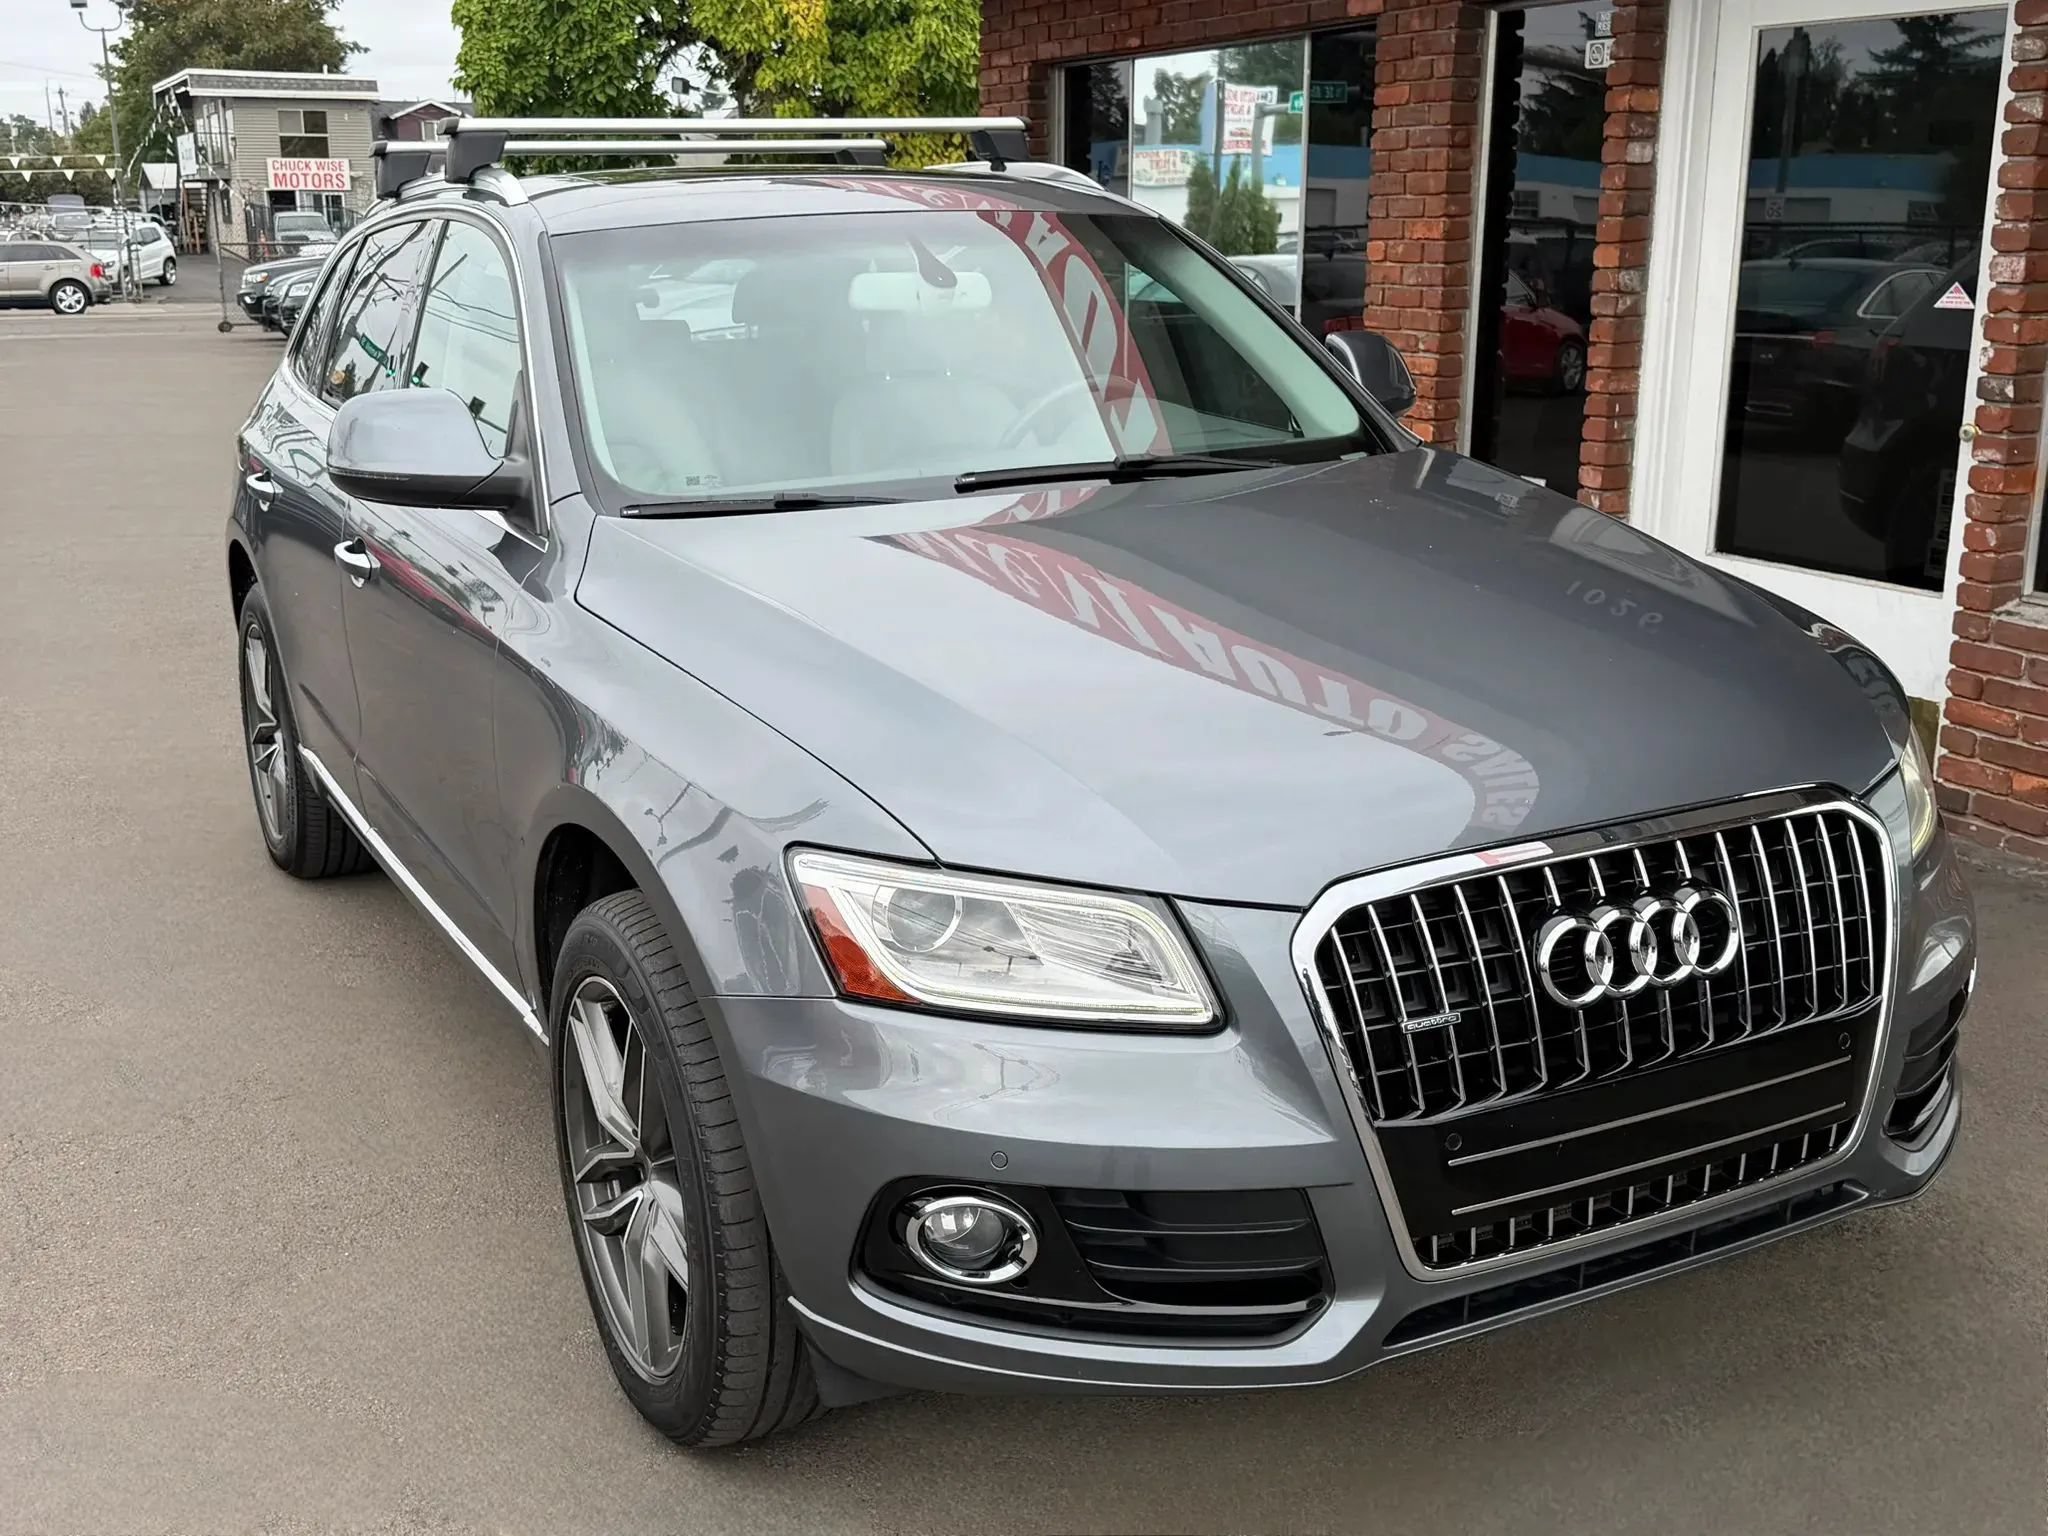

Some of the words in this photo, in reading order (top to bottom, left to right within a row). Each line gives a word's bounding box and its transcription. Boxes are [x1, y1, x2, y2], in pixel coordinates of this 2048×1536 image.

[272, 160, 312, 171] CHUCK
[314, 160, 345, 172] WISE
[273, 173, 346, 189] MOTORS
[1407, 1015, 1457, 1031] quattro
